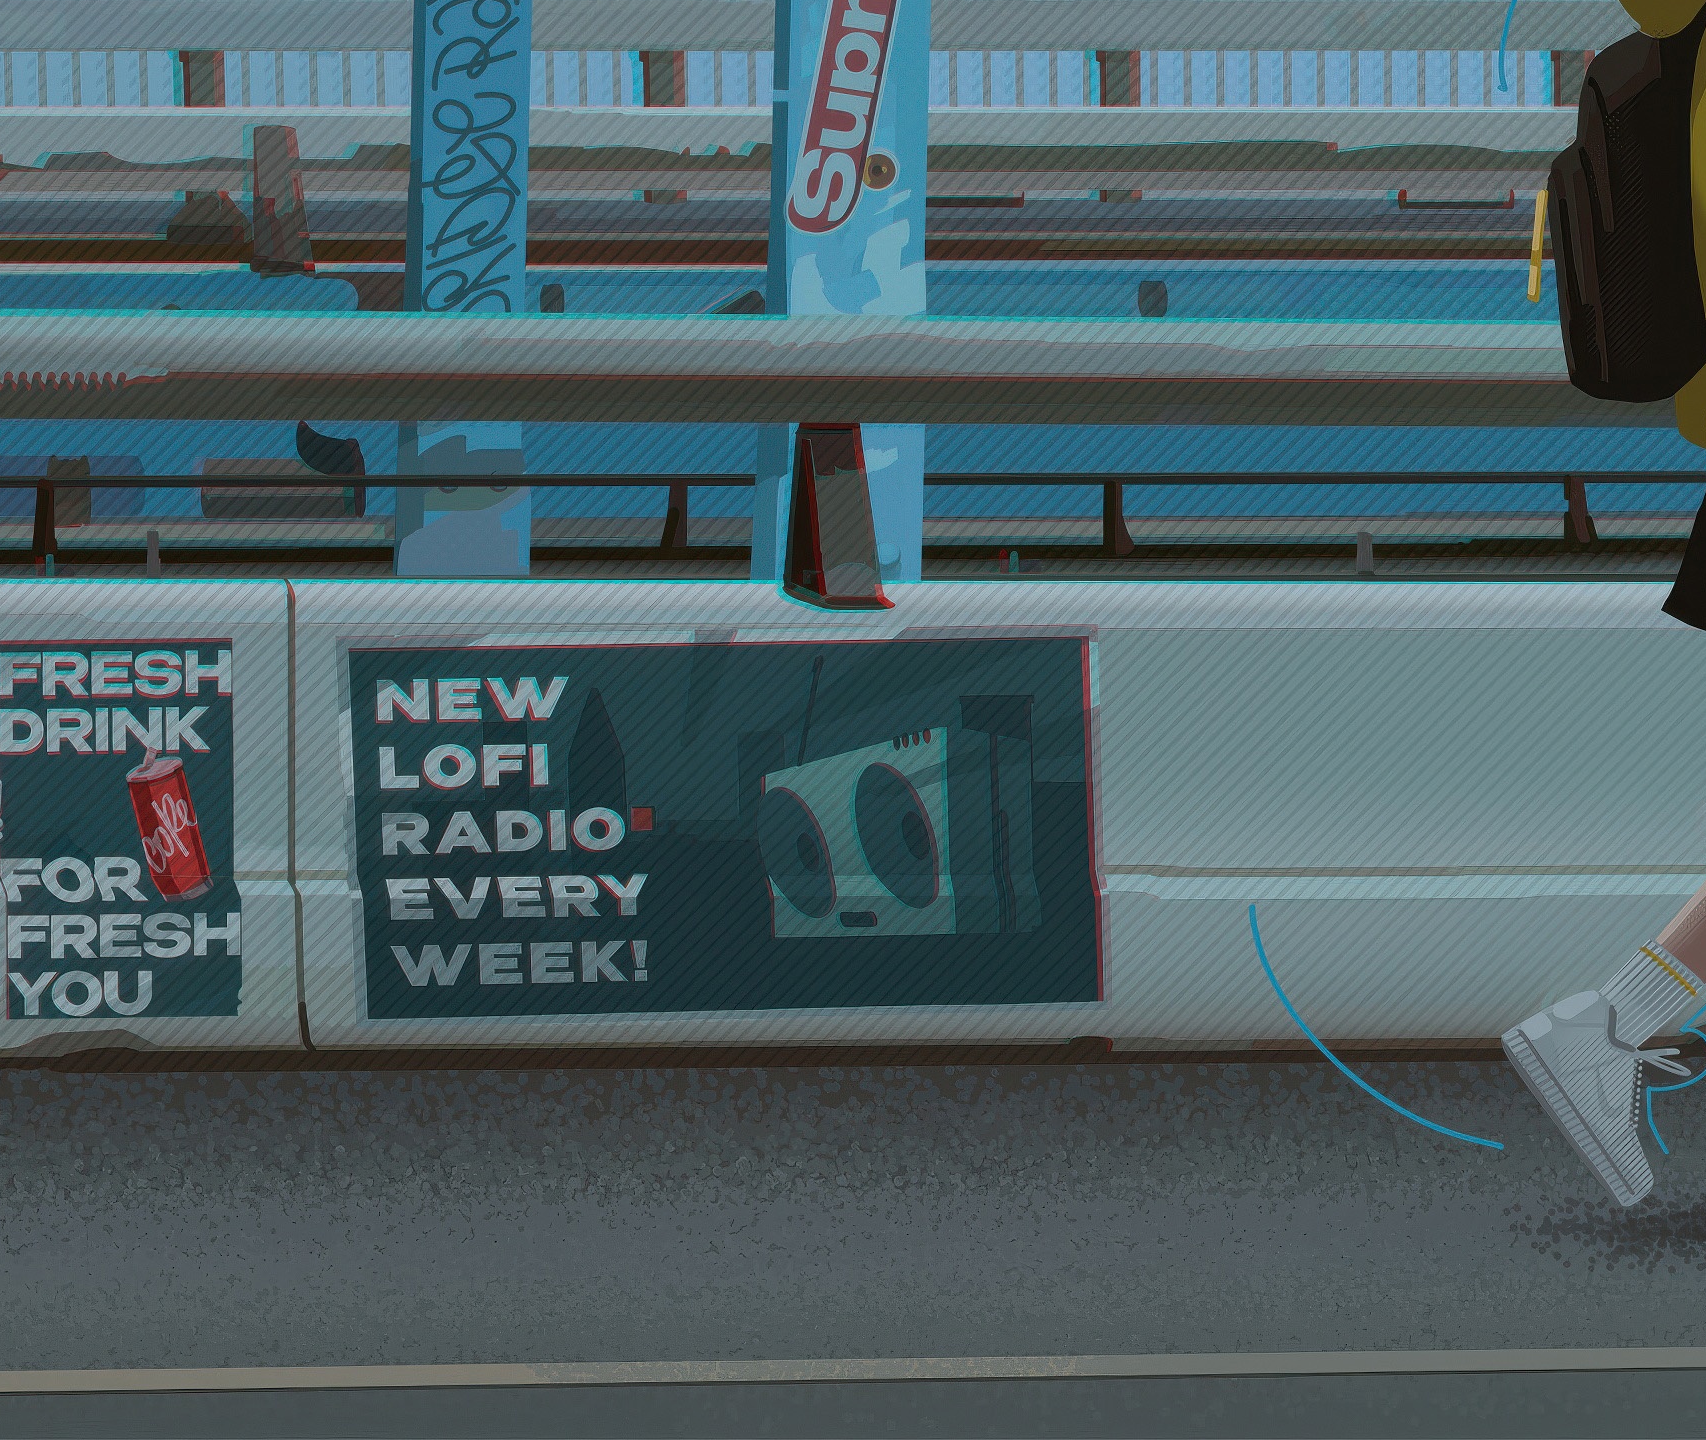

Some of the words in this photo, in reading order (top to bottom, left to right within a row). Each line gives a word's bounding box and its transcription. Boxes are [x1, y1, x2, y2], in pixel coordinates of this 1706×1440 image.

[0, 650, 232, 699] FRESH
[375, 676, 569, 723] NEW
[0, 706, 211, 755] DRINK
[378, 743, 548, 790] LOFI
[381, 807, 626, 856] RADIO
[0, 856, 149, 903] FOR
[385, 874, 648, 920] EVERY
[7, 912, 241, 959] FRESH
[390, 940, 648, 986] WEEK!
[7, 970, 153, 1017] YOU
